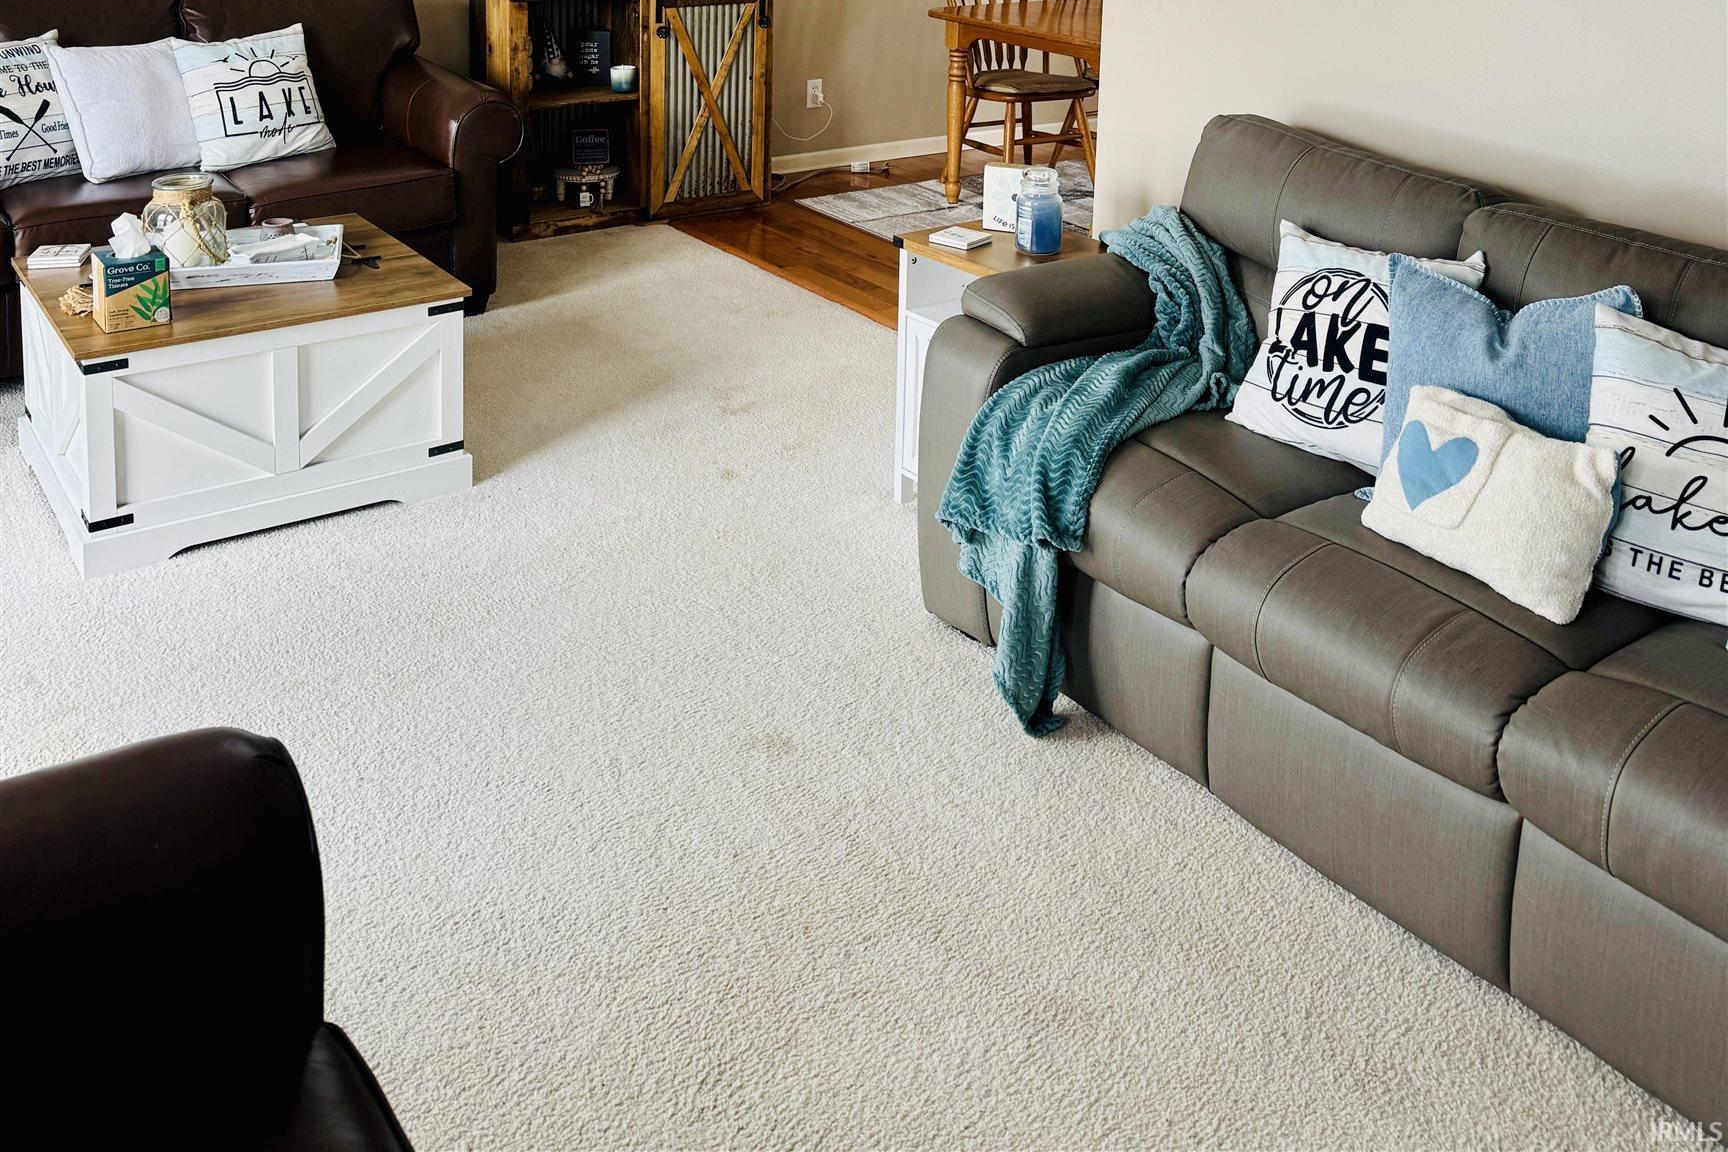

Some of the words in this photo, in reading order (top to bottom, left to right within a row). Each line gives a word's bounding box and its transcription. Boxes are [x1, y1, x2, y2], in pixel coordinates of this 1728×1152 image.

[229, 86, 311, 125] LAKE
[41, 123, 57, 133] Good
[575, 134, 606, 144] Coffee
[4, 163, 20, 177] THE
[20, 159, 42, 172] BEST
[107, 266, 135, 275] Grove
[1302, 275, 1375, 328] on
[1271, 348, 1380, 425] time
[1630, 547, 1684, 580] THE
